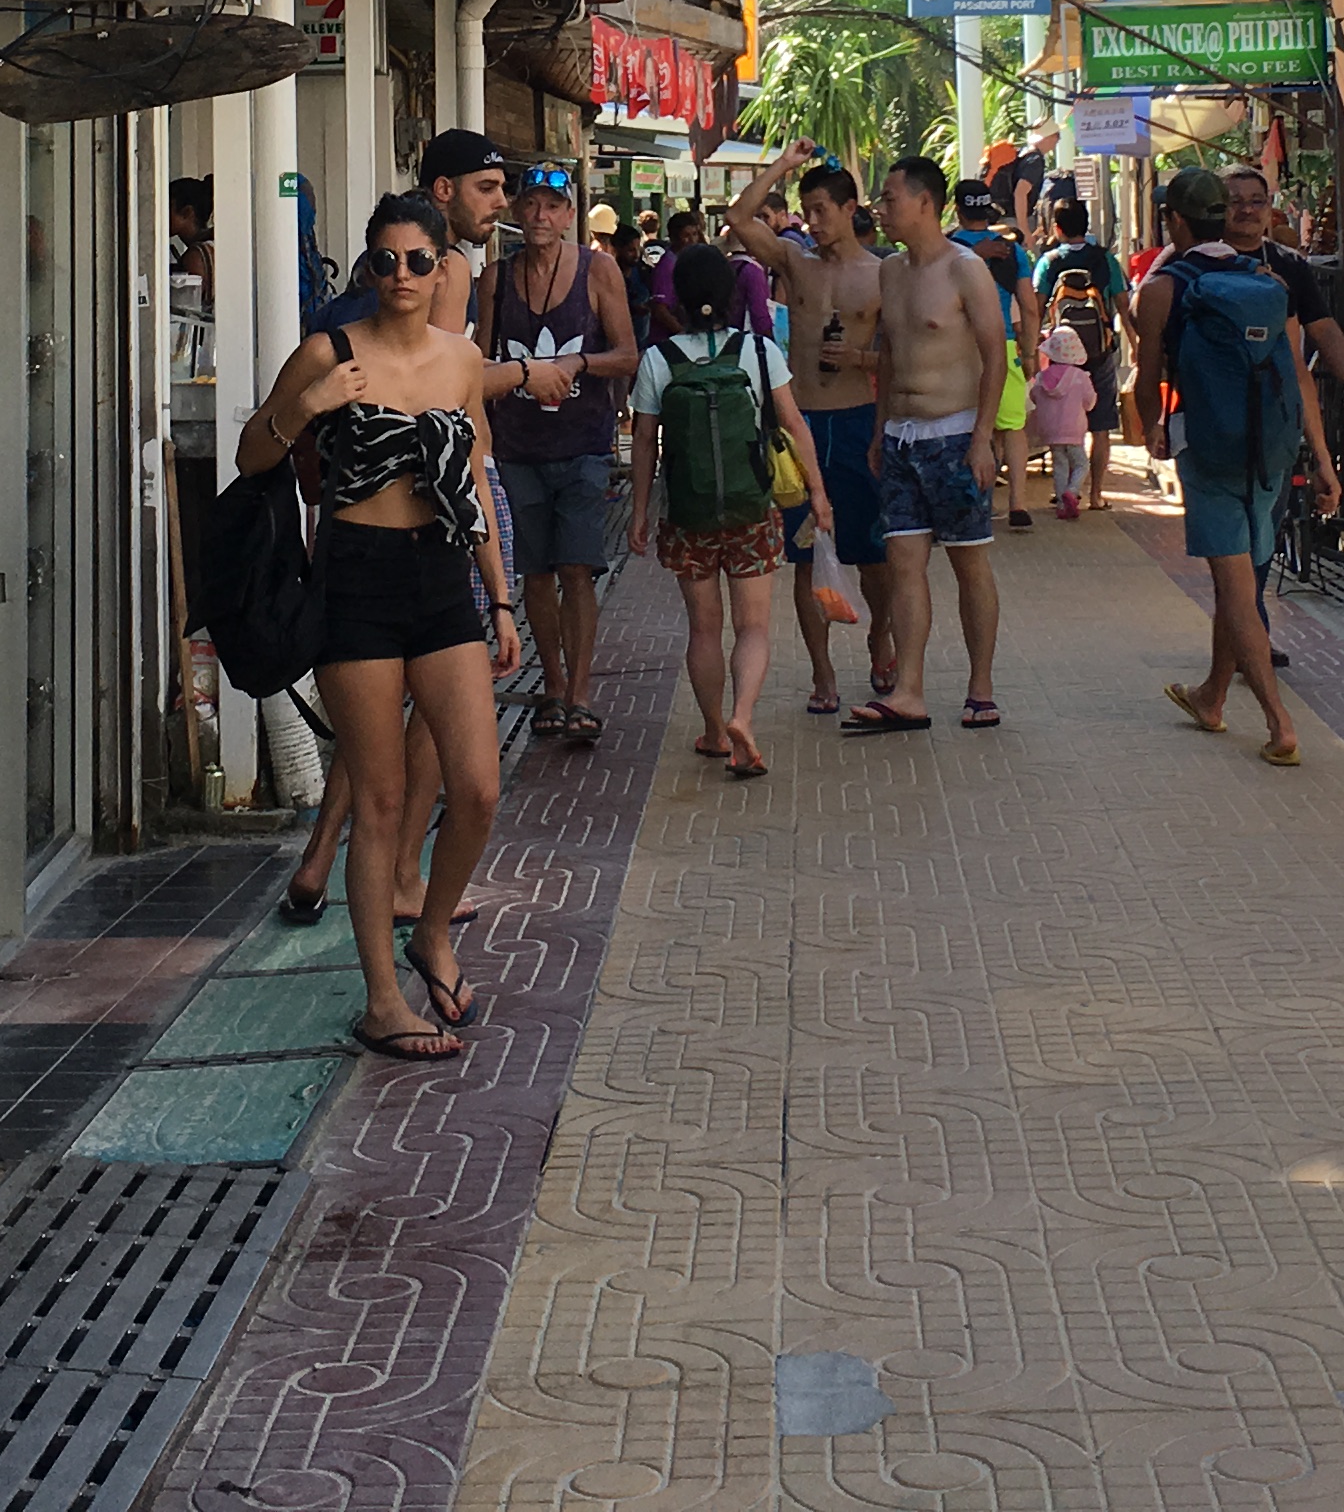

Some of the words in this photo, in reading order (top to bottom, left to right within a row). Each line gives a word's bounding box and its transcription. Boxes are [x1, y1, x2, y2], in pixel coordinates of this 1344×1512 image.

[953, 0, 1009, 10] PASSENGER
[1010, 0, 1036, 9] PORT
[1112, 65, 1162, 79] BEST
[1227, 61, 1257, 75] NO
[1262, 59, 1302, 74] FEE
